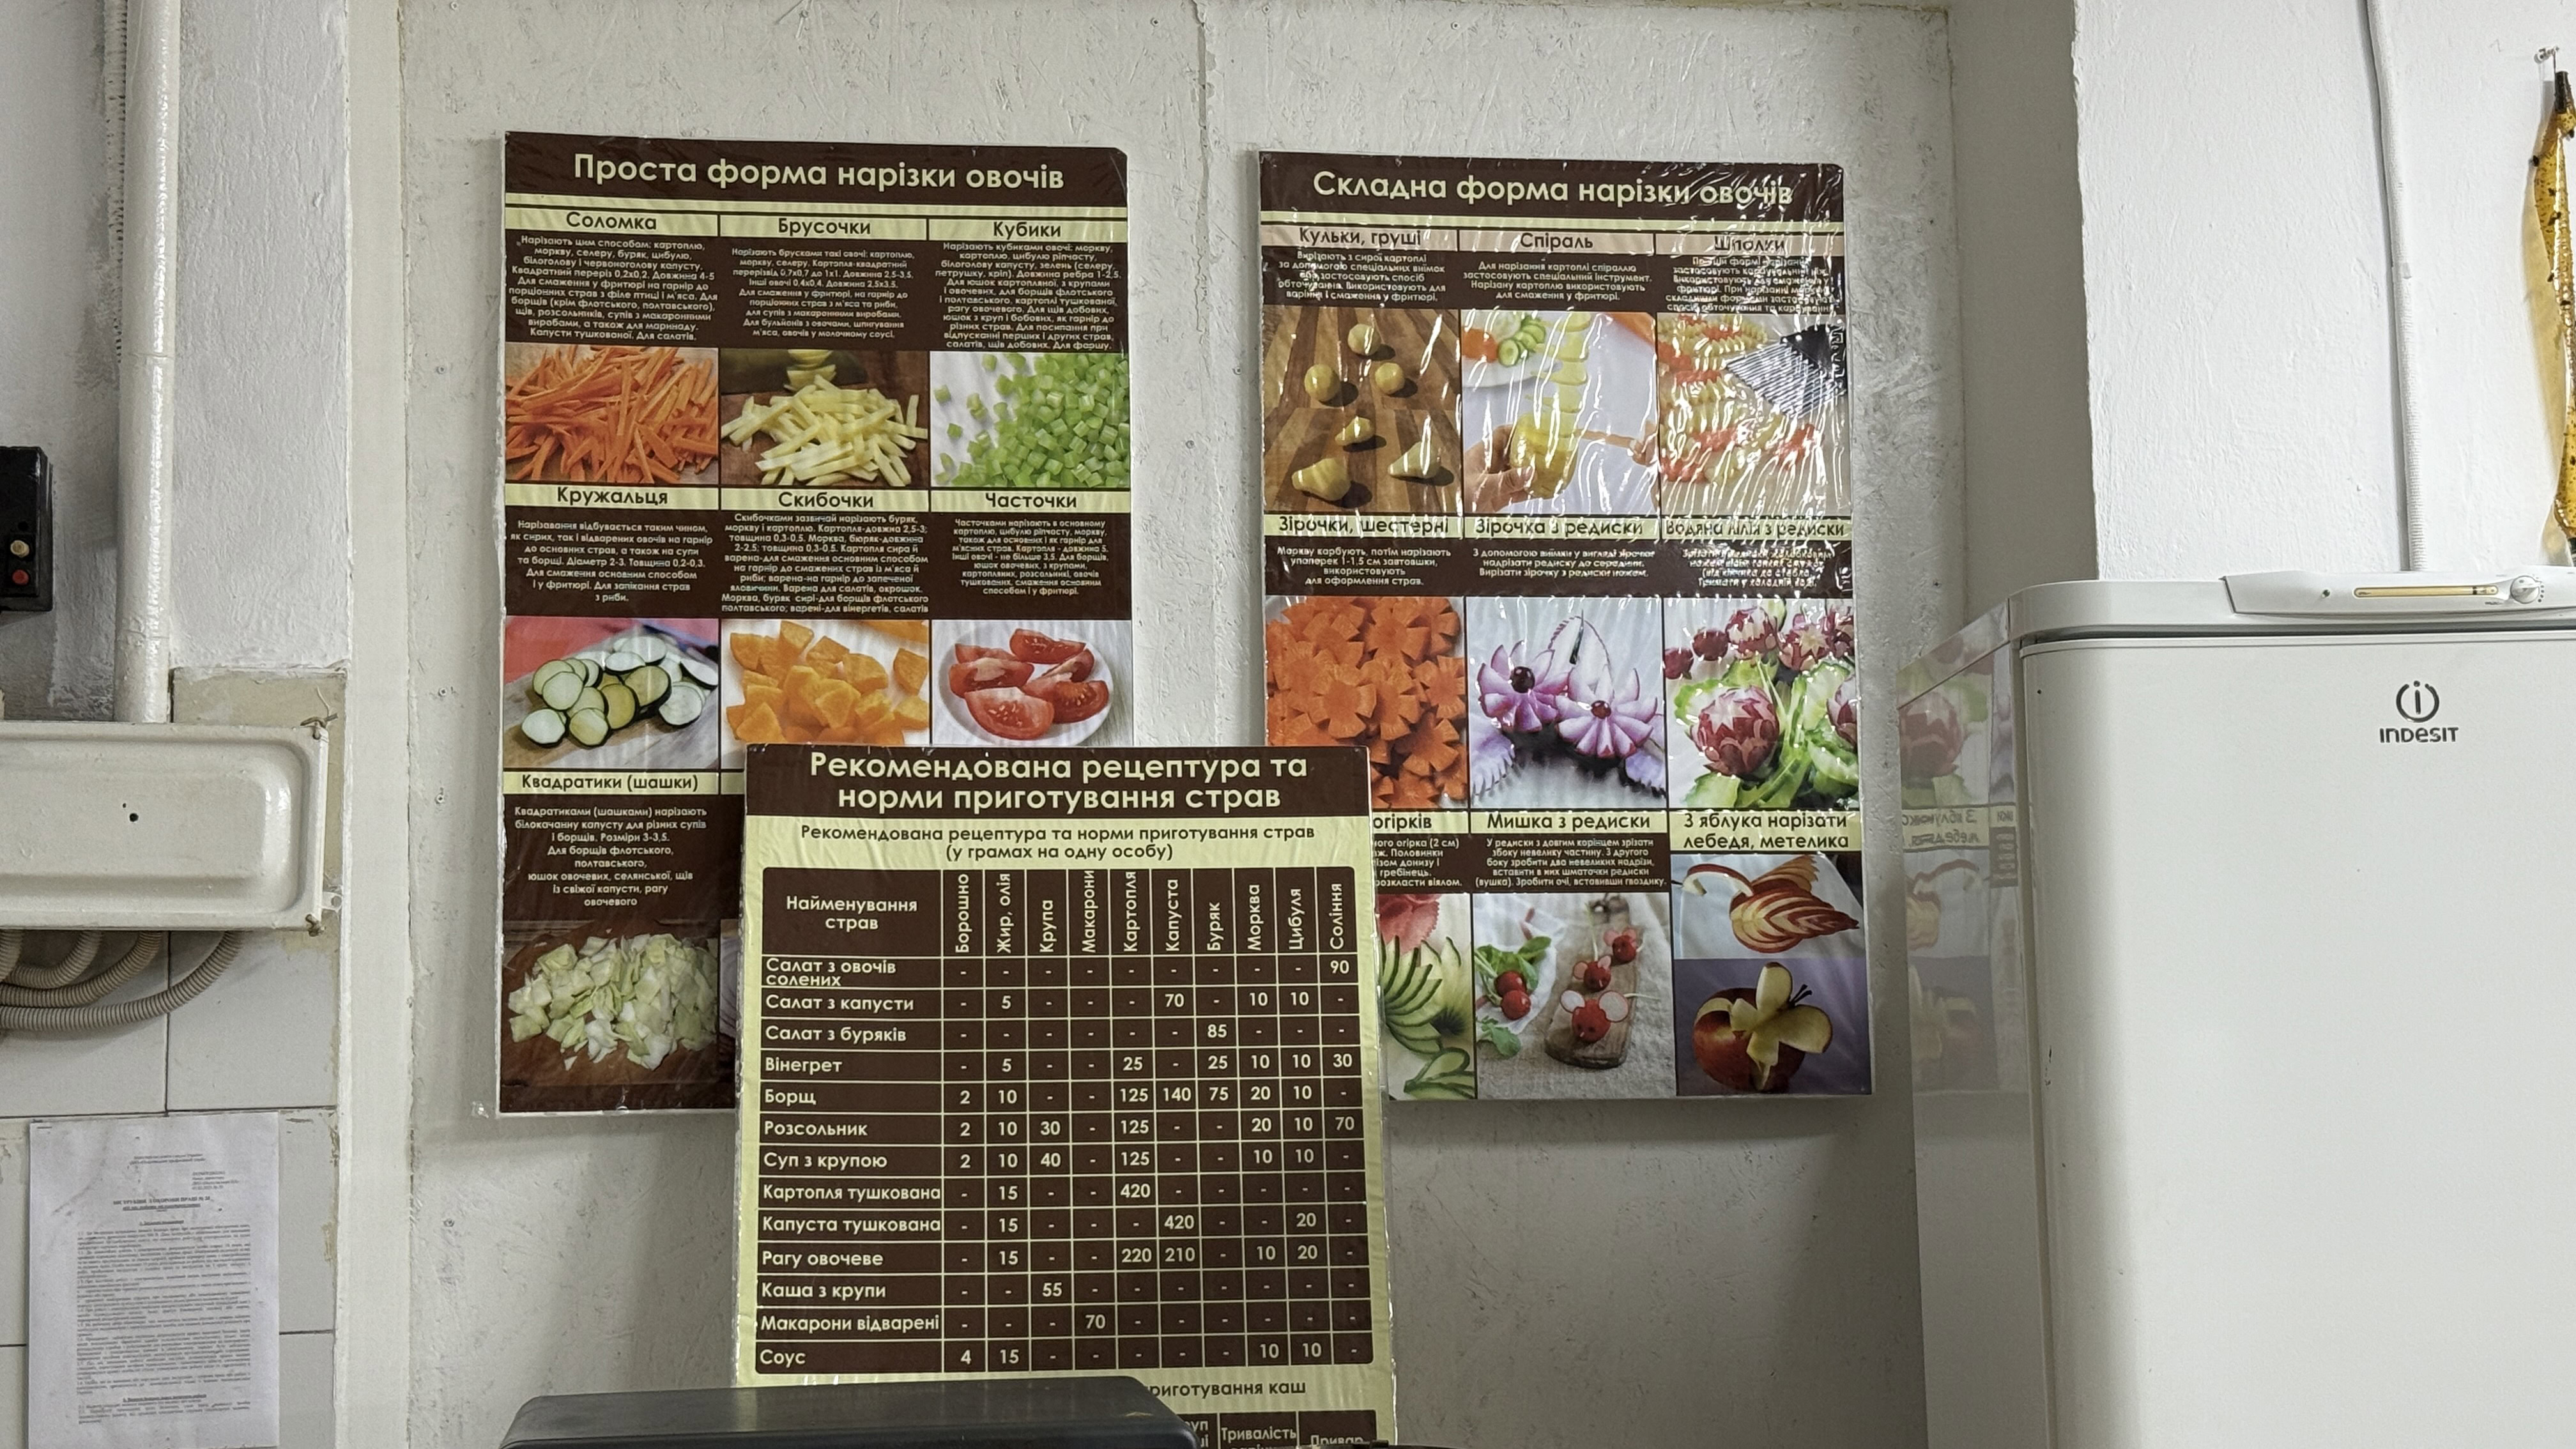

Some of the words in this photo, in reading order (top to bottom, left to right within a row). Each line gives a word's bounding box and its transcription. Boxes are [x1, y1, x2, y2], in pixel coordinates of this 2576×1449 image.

[575, 153, 696, 185] Проста
[708, 158, 826, 189] форма
[838, 162, 954, 192] нарізки
[966, 164, 1064, 188] овочів
[1314, 171, 1446, 199] Складна
[1457, 175, 1568, 205] форма
[1579, 178, 1692, 208] нарізки
[1700, 180, 1792, 204] овочів
[566, 211, 656, 230] Соломка
[779, 218, 870, 237] Брусочки
[993, 221, 1061, 240] Кубики
[1300, 227, 1365, 246] Кульки,
[1371, 230, 1421, 248] груші
[1520, 233, 1593, 252] Спіраль
[576, 250, 615, 259] селеру,
[558, 486, 668, 506] Кружальця
[779, 491, 873, 507] Скибочки
[986, 493, 1077, 508] Часточки
[1279, 516, 1353, 535] Зірочки,
[1360, 518, 1448, 536] шестерні
[1476, 518, 1545, 537] Зірочка
[1551, 522, 1559, 534] з
[1565, 523, 1643, 537] редиски
[1666, 520, 1723, 537] Водяна
[1765, 524, 1772, 535] з
[594, 581, 611, 590] Для
[811, 752, 1071, 781] Рекомендована
[1083, 759, 1260, 784] рецептура
[1270, 759, 1307, 777] та
[523, 774, 622, 792] Квадратики
[627, 774, 698, 792] (шашки)
[839, 789, 942, 814] норми
[954, 790, 1174, 814] приготування
[1186, 789, 1280, 813] страв
[515, 807, 591, 817] Квадратиками
[594, 806, 652, 818] (шашками)
[581, 822, 624, 831] капусту
[1372, 813, 1432, 832] огірків
[1487, 811, 1552, 829] Мишка
[1558, 816, 1566, 828] з
[1572, 816, 1650, 832] редиски
[1684, 813, 1694, 828] З
[1699, 813, 1761, 831] яблука
[1768, 812, 1846, 831] нарізати
[802, 825, 943, 841] Рекомендована
[949, 830, 1046, 843] рецептура
[1052, 830, 1071, 840] та
[1078, 830, 1133, 843] норми
[1140, 829, 1257, 843] приготування
[1263, 828, 1314, 841] страв
[1397, 838, 1427, 848] огірка
[1683, 833, 1754, 850] лебедя,
[1760, 836, 1848, 848] метелика
[548, 846, 567, 855] Для
[569, 845, 607, 856] борщів
[610, 845, 673, 856] флотського,
[946, 845, 963, 862] (у
[969, 848, 1032, 861] грамах
[1038, 848, 1059, 858] на
[1064, 847, 1107, 861] одну
[1112, 843, 1172, 861] особу)
[996, 873, 1011, 906] олія
[1428, 877, 1462, 886] віялом.
[787, 896, 917, 914] Найменування
[955, 874, 972, 953] Борошно
[1082, 871, 1098, 953] Макарони
[1124, 871, 1140, 951] Картопля
[1165, 880, 1182, 951] Капуста
[1248, 885, 1264, 951] Морква
[1288, 889, 1305, 949] Цибуля
[1329, 884, 1344, 949] Соління
[825, 918, 878, 932] страв
[997, 912, 1014, 953] Жир,
[1039, 900, 1057, 952] Крупа
[1207, 902, 1224, 951] Буряк
[767, 958, 823, 972] Салат
[828, 962, 835, 972] з
[841, 960, 896, 973] овочів
[1330, 960, 1349, 974] 90
[766, 975, 841, 986] солених
[766, 994, 822, 1009] Салат
[827, 999, 835, 1009] з
[841, 999, 914, 1013] капусти
[765, 1025, 822, 1040] Салат
[827, 1030, 835, 1040] з
[841, 1027, 906, 1044] буряків
[765, 1057, 842, 1075] Вінегрет
[765, 1089, 816, 1107] Борщ
[960, 1091, 970, 1104] 2
[999, 1090, 1017, 1103] 10
[1120, 1088, 1148, 1102] 125
[1163, 1087, 1191, 1101] 140
[1209, 1087, 1229, 1101] 75
[1251, 1086, 1270, 1100] 20
[1294, 1085, 1312, 1099] 10
[765, 1121, 868, 1135] Розсольник
[764, 1152, 799, 1170] Суп
[804, 1156, 812, 1167] з
[818, 1156, 887, 1170] крупою
[764, 1184, 842, 1202] Картопля
[847, 1188, 940, 1202] тушкована
[763, 1216, 837, 1234] Капуста
[843, 1220, 940, 1234] тушкована
[763, 1251, 802, 1269] Рагу
[808, 1254, 883, 1266] овочеве
[762, 1282, 813, 1297] Каша
[819, 1286, 826, 1297] з
[832, 1286, 885, 1301] крупи
[761, 1315, 852, 1333] Макарони
[857, 1315, 939, 1333] відварені
[760, 1349, 806, 1368] Соус
[1269, 1383, 1306, 1394] каш
[1221, 1426, 1296, 1443] Тривалість
